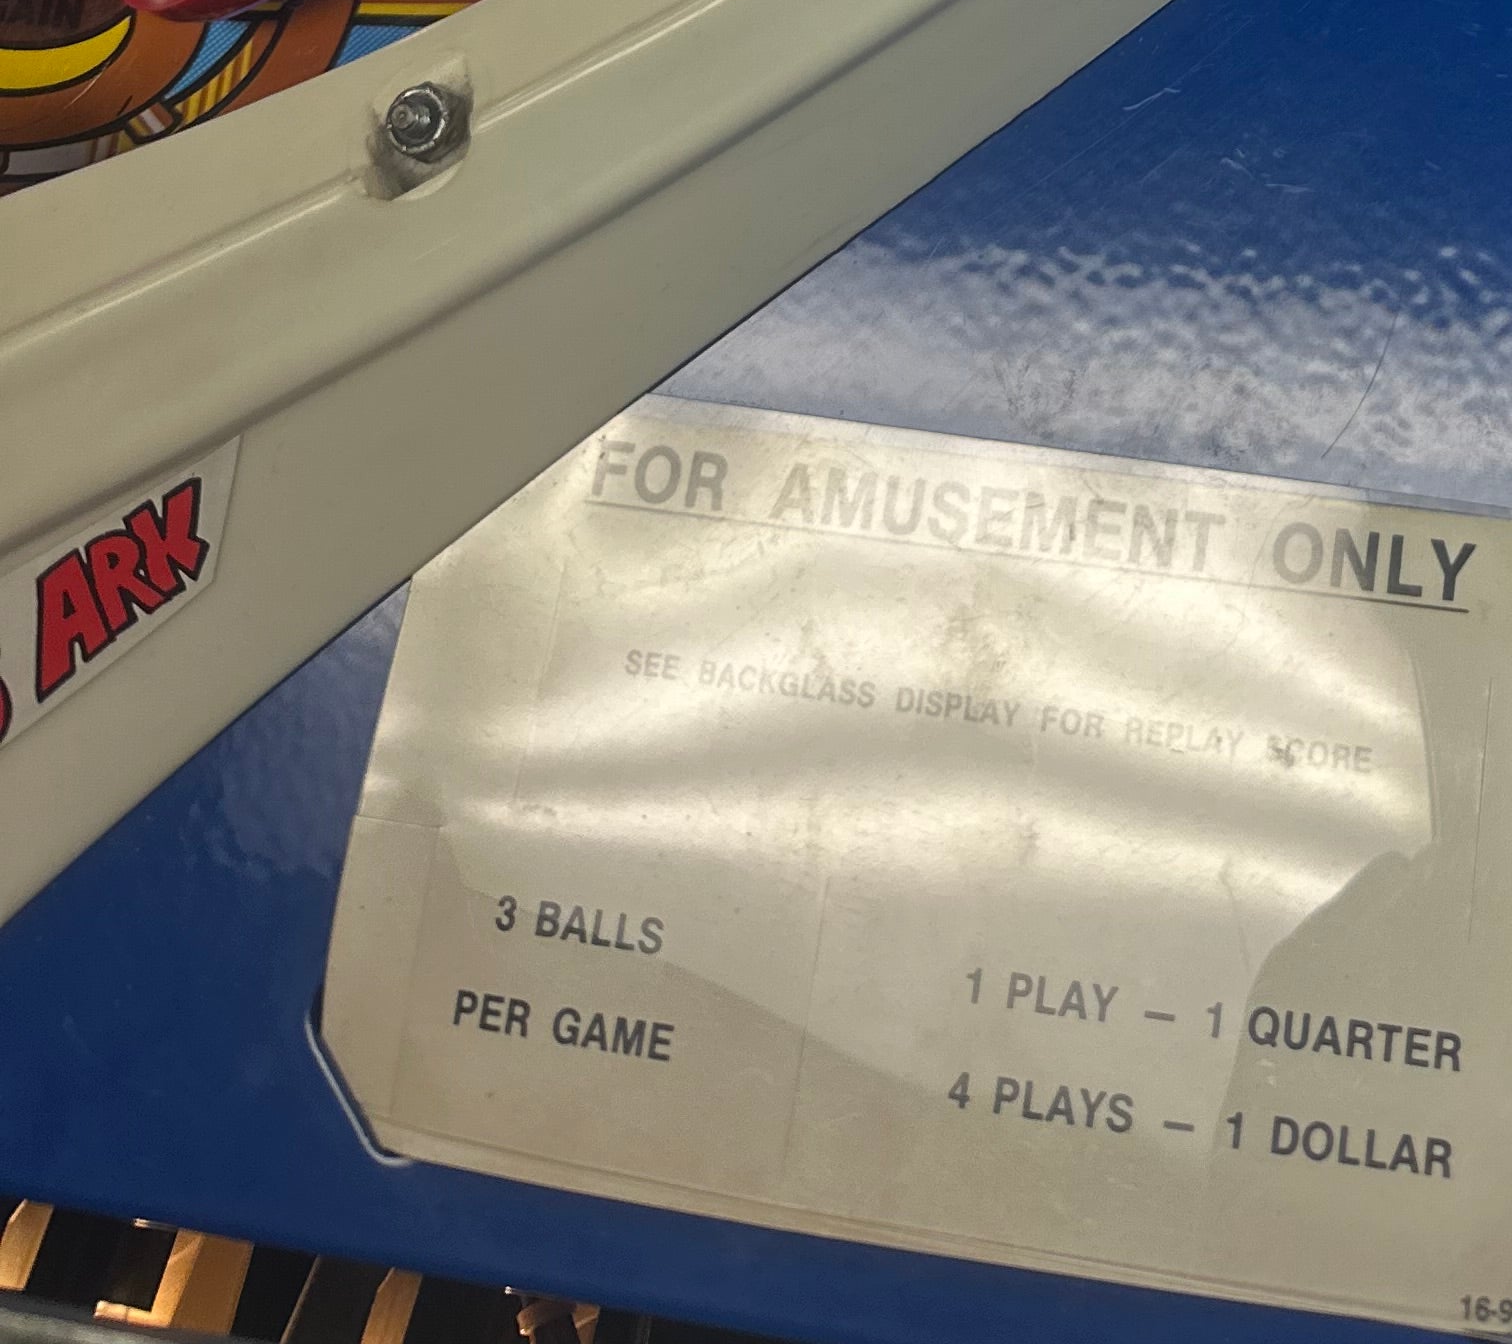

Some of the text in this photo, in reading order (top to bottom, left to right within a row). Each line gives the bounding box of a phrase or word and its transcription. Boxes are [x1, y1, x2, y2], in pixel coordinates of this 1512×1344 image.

[588, 441, 1477, 602] FOR AMUSEMENT ONLY
[36, 476, 210, 704] ARK
[624, 648, 1374, 774] SEE BACKGLASS DISPLAY FOR REPLAY SCORE
[495, 894, 665, 955] 3 BALLS
[452, 989, 676, 1062] PER GAME
[966, 967, 983, 1004] 1
[1006, 971, 1119, 1023] PLAY
[1206, 1002, 1223, 1039] 1
[1248, 1005, 1462, 1072] QUARTER
[948, 1071, 971, 1110] 4
[992, 1076, 1135, 1134] PLAYS
[1226, 1111, 1245, 1149] 1
[1271, 1115, 1453, 1178] DOLLAR
